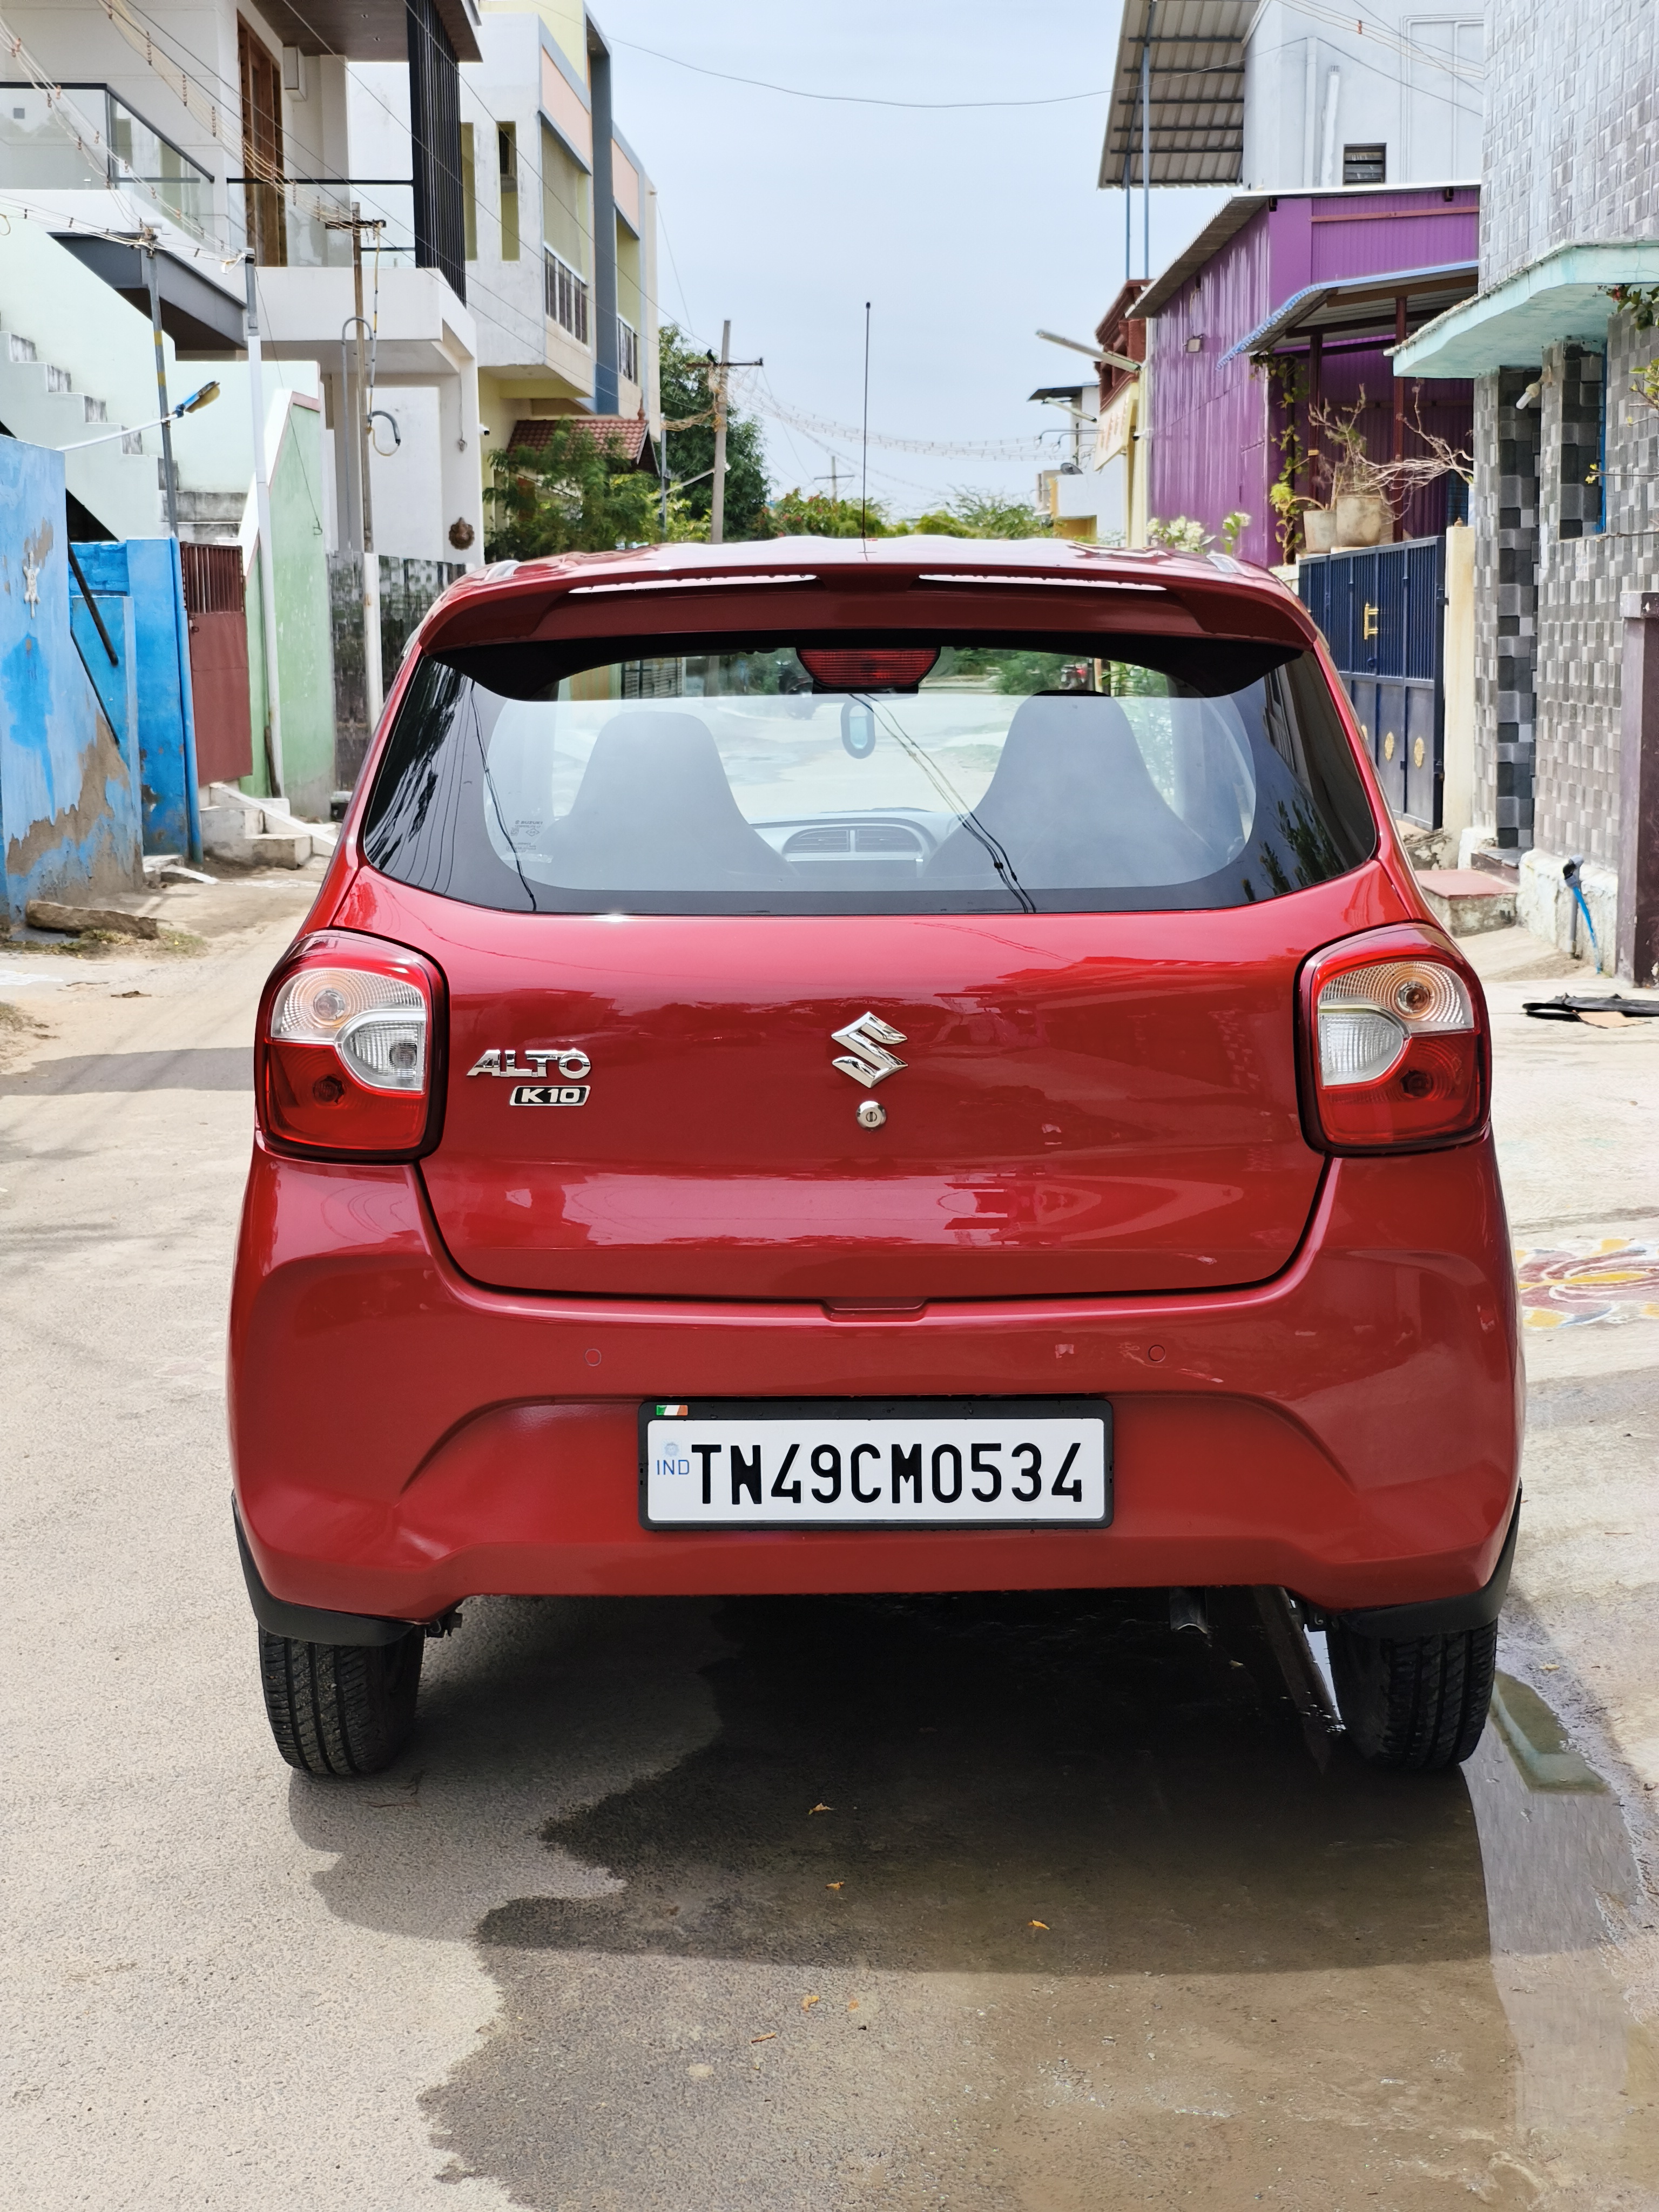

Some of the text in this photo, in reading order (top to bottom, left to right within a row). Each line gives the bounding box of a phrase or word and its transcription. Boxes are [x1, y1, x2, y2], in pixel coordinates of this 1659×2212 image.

[467, 1048, 591, 1079] ALTO
[520, 1088, 581, 1103] K10
[657, 1459, 690, 1475] IND
[691, 1442, 1082, 1505] TN49CM0534
